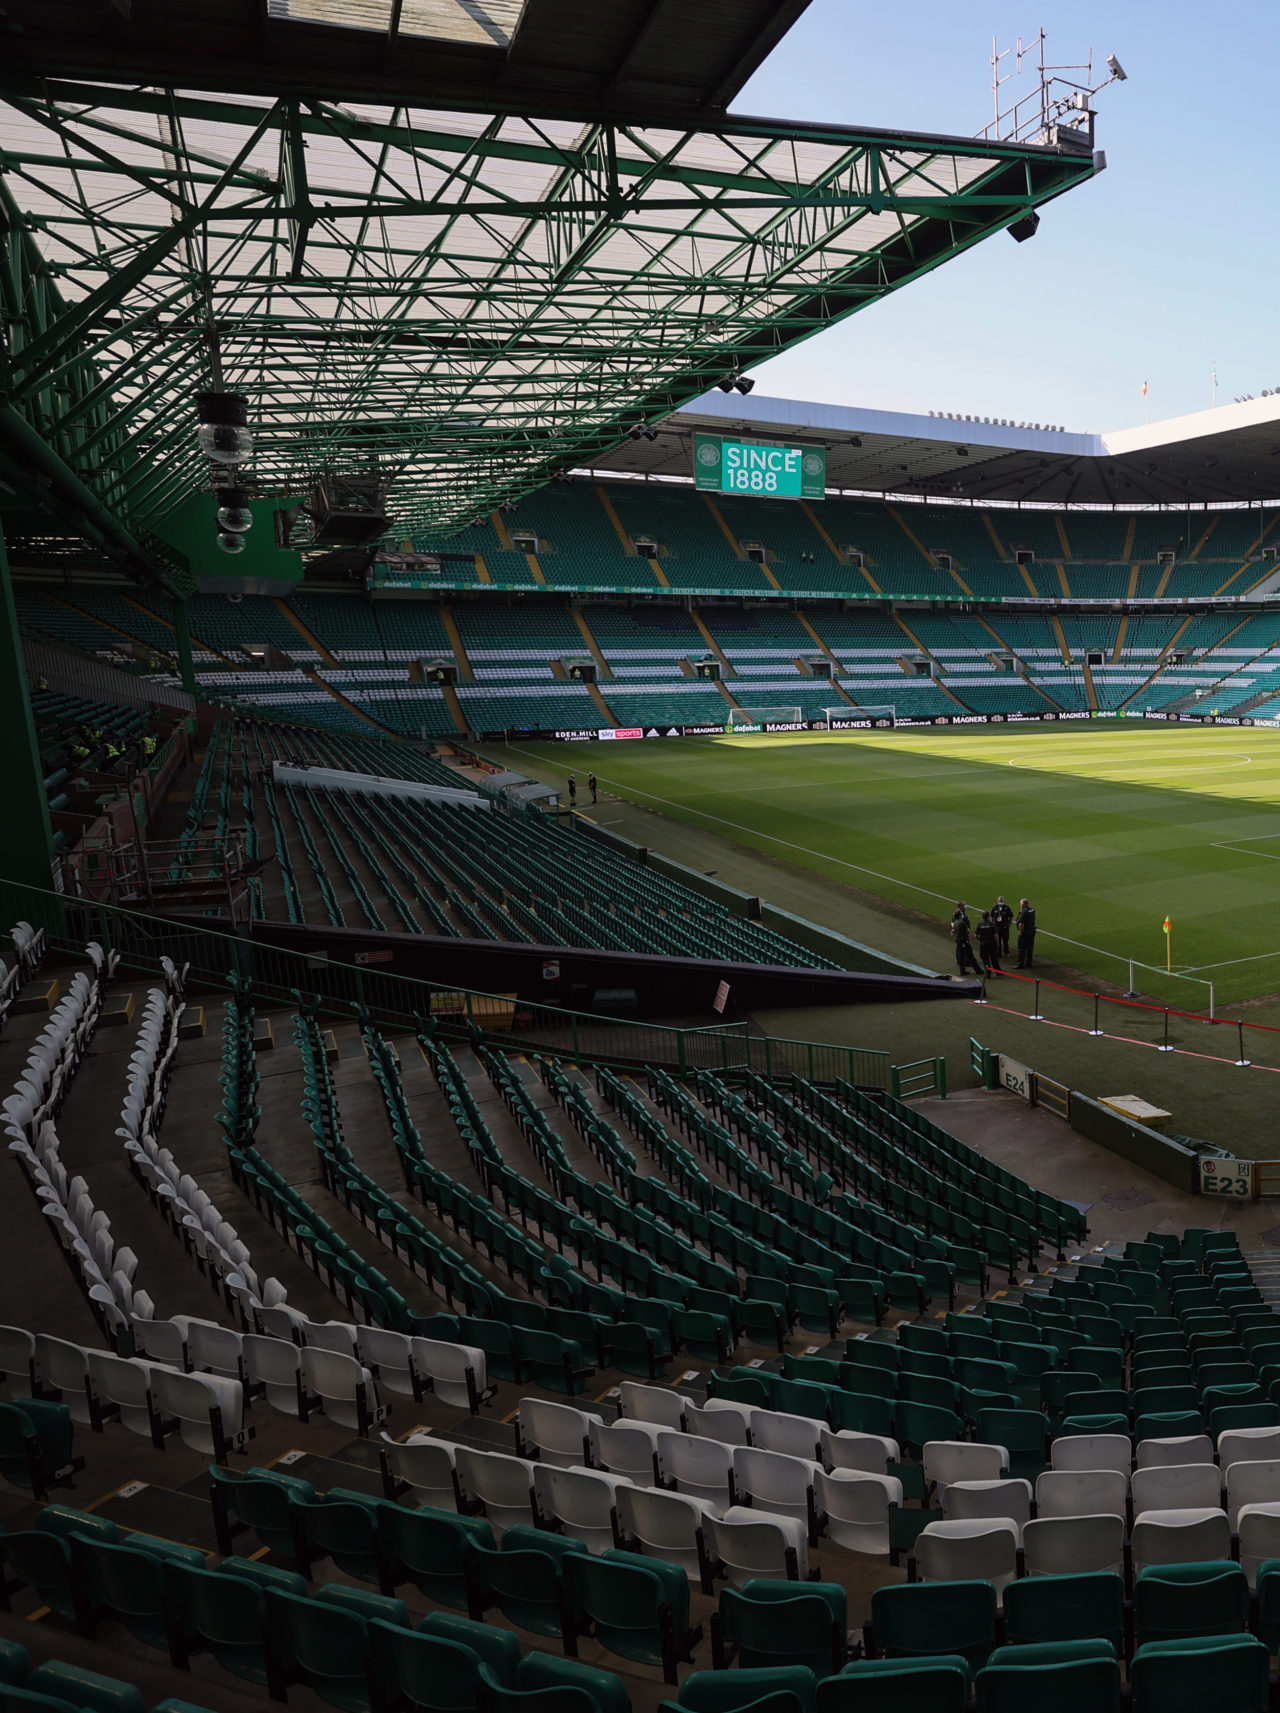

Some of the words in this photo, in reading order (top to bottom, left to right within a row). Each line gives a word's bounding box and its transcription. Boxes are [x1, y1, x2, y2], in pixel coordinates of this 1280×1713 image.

[727, 447, 798, 472] SINCE
[727, 468, 778, 491] 1888
[384, 581, 412, 589] dafabet
[593, 585, 617, 593] dafabet
[953, 715, 988, 724] MAGNERS
[1059, 711, 1090, 720] MAGNERS
[1146, 711, 1167, 720] MAGNERS
[1215, 716, 1240, 726] MAGNERS
[1254, 718, 1280, 728] MAGNERS
[693, 726, 724, 734] MAGNERS
[733, 725, 761, 733] dafabet
[601, 730, 614, 740] sky
[615, 730, 641, 738] sports
[1005, 1072, 1025, 1094] E24
[1203, 1175, 1249, 1196] E23
